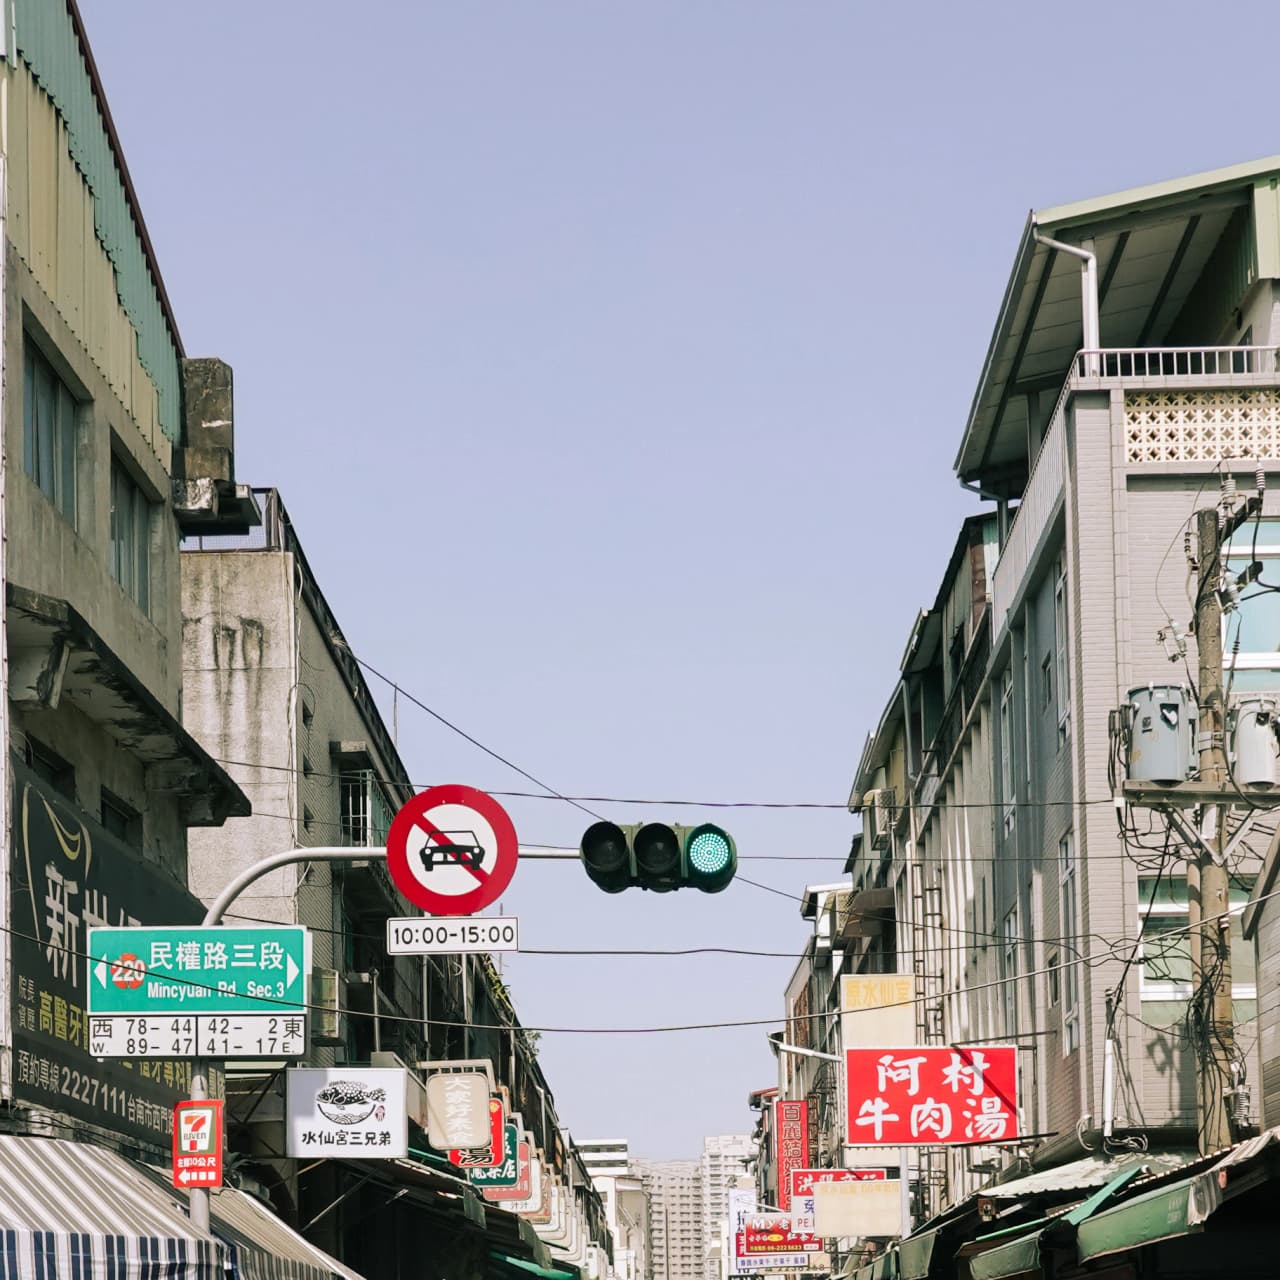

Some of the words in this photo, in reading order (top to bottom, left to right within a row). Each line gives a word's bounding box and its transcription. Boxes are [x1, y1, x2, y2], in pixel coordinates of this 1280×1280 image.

[393, 926, 515, 947] 10:00-15:00
[148, 941, 284, 971] 民權路三段
[111, 960, 145, 983] 220
[147, 981, 211, 1002] Mincyuan
[247, 981, 285, 998] Sec.3
[92, 1018, 113, 1039] 西
[126, 1018, 160, 1036] 78-
[171, 1018, 193, 1036] 44
[208, 1018, 243, 1035] 42-
[269, 1018, 278, 1034] 2
[283, 1018, 303, 1039] 東
[126, 1038, 160, 1055] 89-
[171, 1038, 193, 1054] 47
[256, 1038, 277, 1054] 17
[877, 1051, 990, 1097] 阿村
[855, 1097, 1010, 1141] 牛肉湯
[302, 1129, 391, 1147] 水仙宮三兄弟
